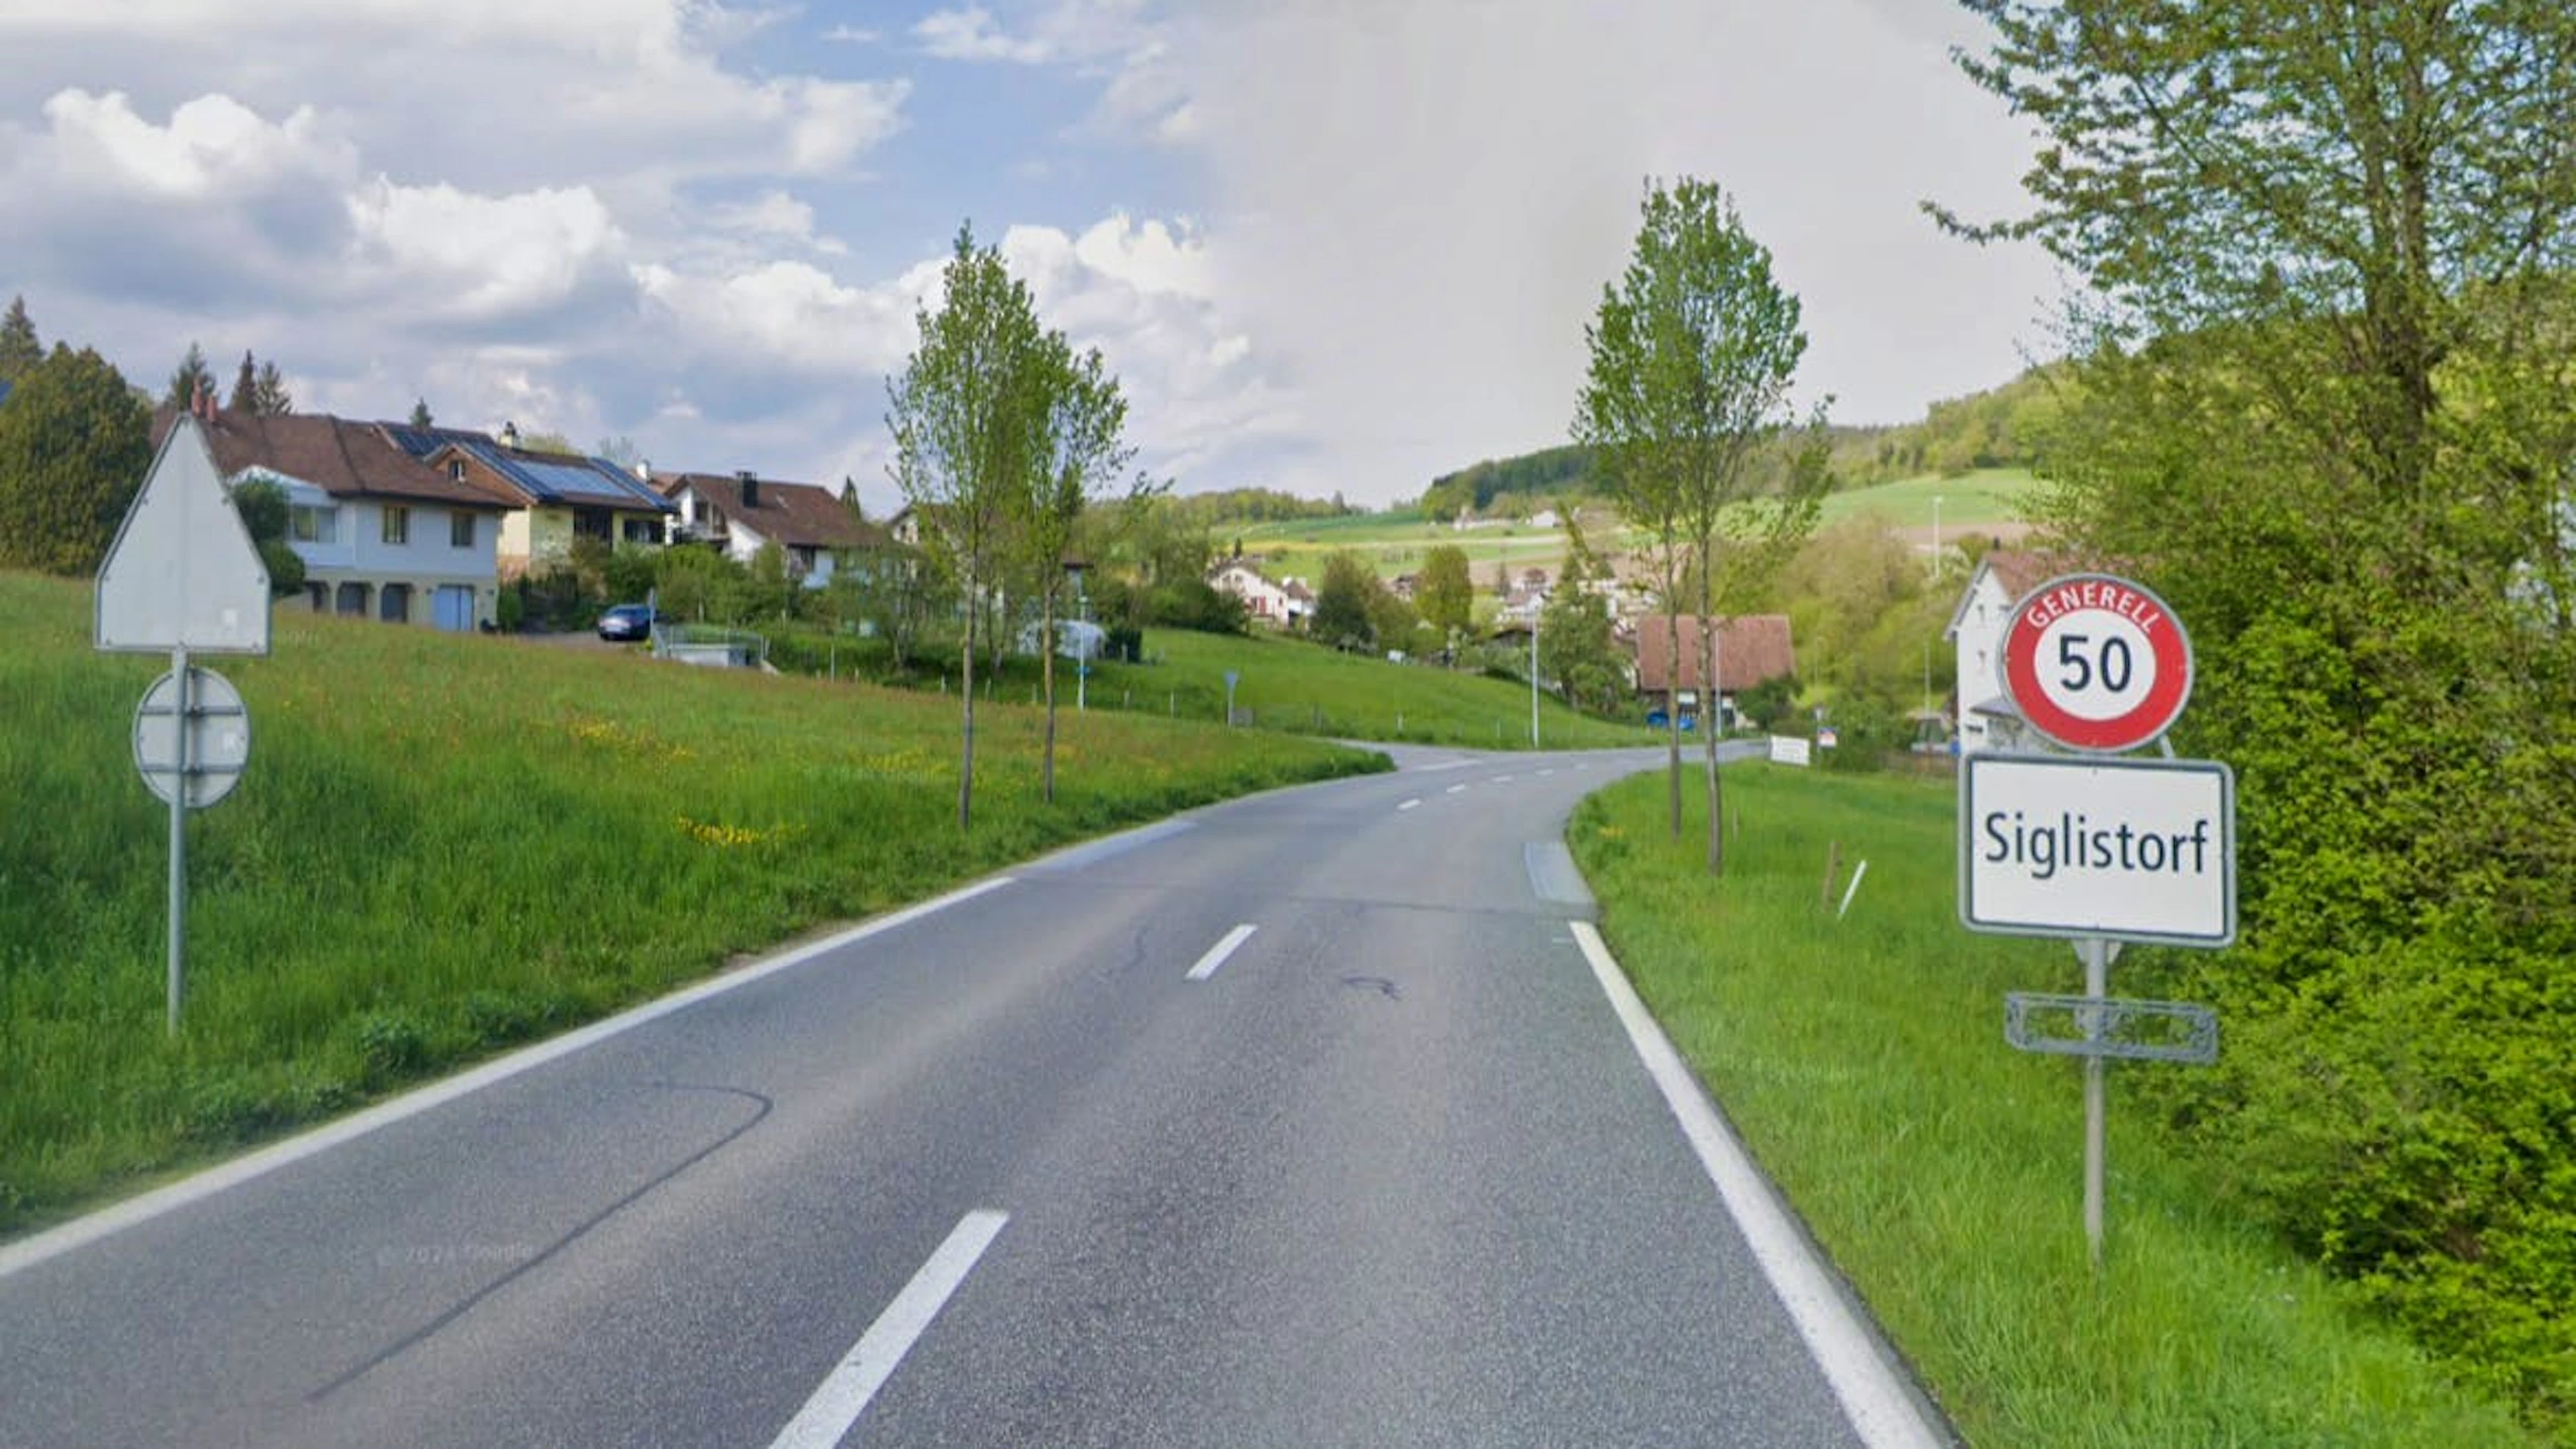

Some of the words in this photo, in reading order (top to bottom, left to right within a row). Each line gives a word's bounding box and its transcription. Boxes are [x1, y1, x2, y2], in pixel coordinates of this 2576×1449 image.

[2027, 582, 2161, 633] GENERELL
[2059, 635, 2132, 692] 50
[1985, 811, 2208, 879] Siglistorf
